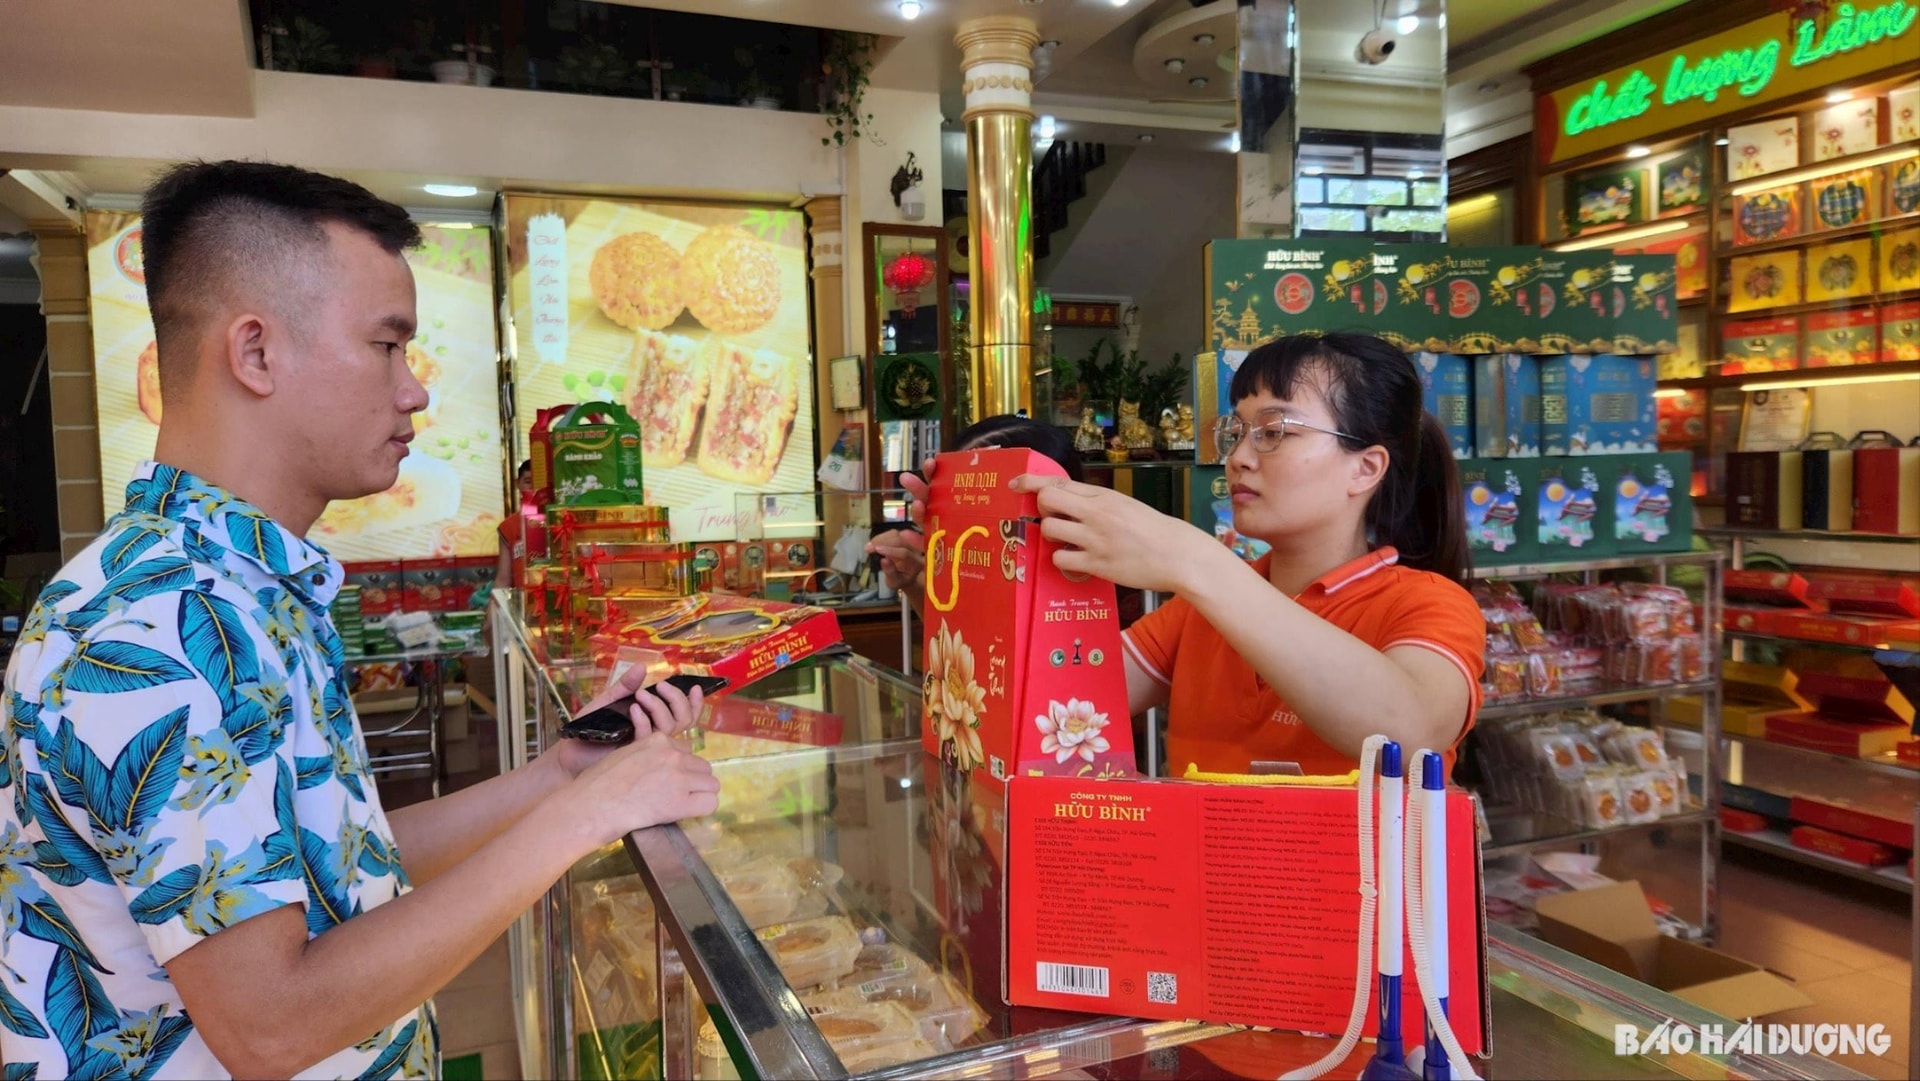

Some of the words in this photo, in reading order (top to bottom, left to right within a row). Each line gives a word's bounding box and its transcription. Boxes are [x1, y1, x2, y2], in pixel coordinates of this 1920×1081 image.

[1790, 1, 1917, 66] Làm
[968, 546, 991, 567] BÌNH
[1044, 608, 1073, 622] HỮU
[1076, 607, 1108, 620] BÌNH
[1070, 792, 1095, 800] CÔNG
[1108, 794, 1132, 802] TNHH
[1054, 801, 1093, 819] HỮU
[1099, 803, 1146, 821] BÌNH
